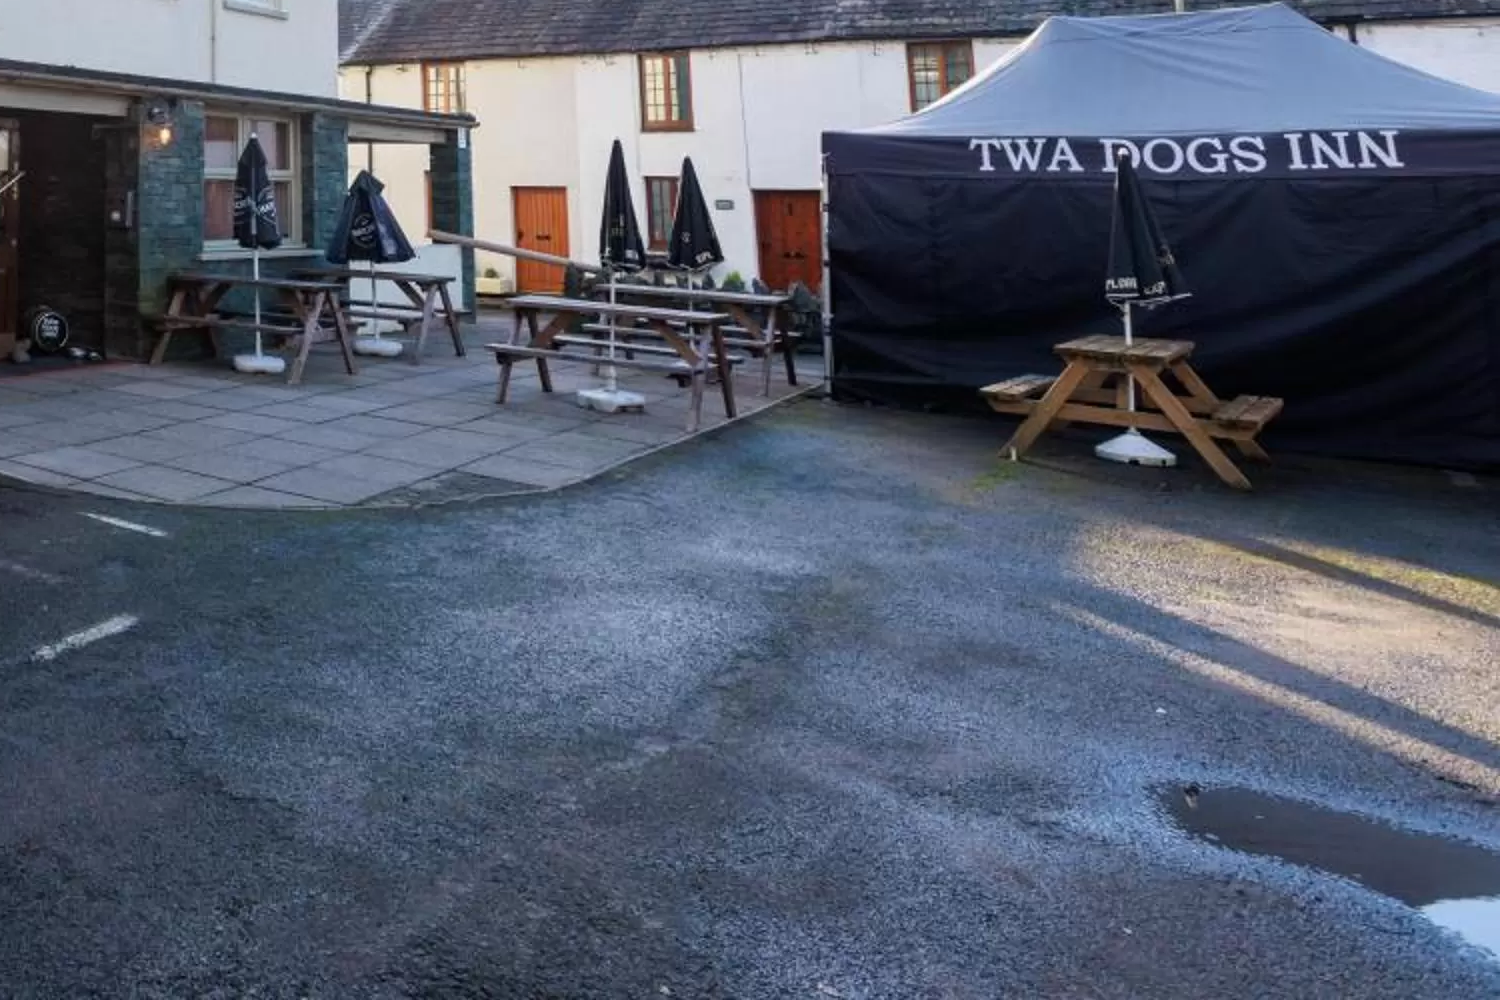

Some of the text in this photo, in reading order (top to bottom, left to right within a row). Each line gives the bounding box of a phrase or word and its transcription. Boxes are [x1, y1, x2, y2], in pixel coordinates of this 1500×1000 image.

[969, 130, 1404, 173] TWA DOGS INN
